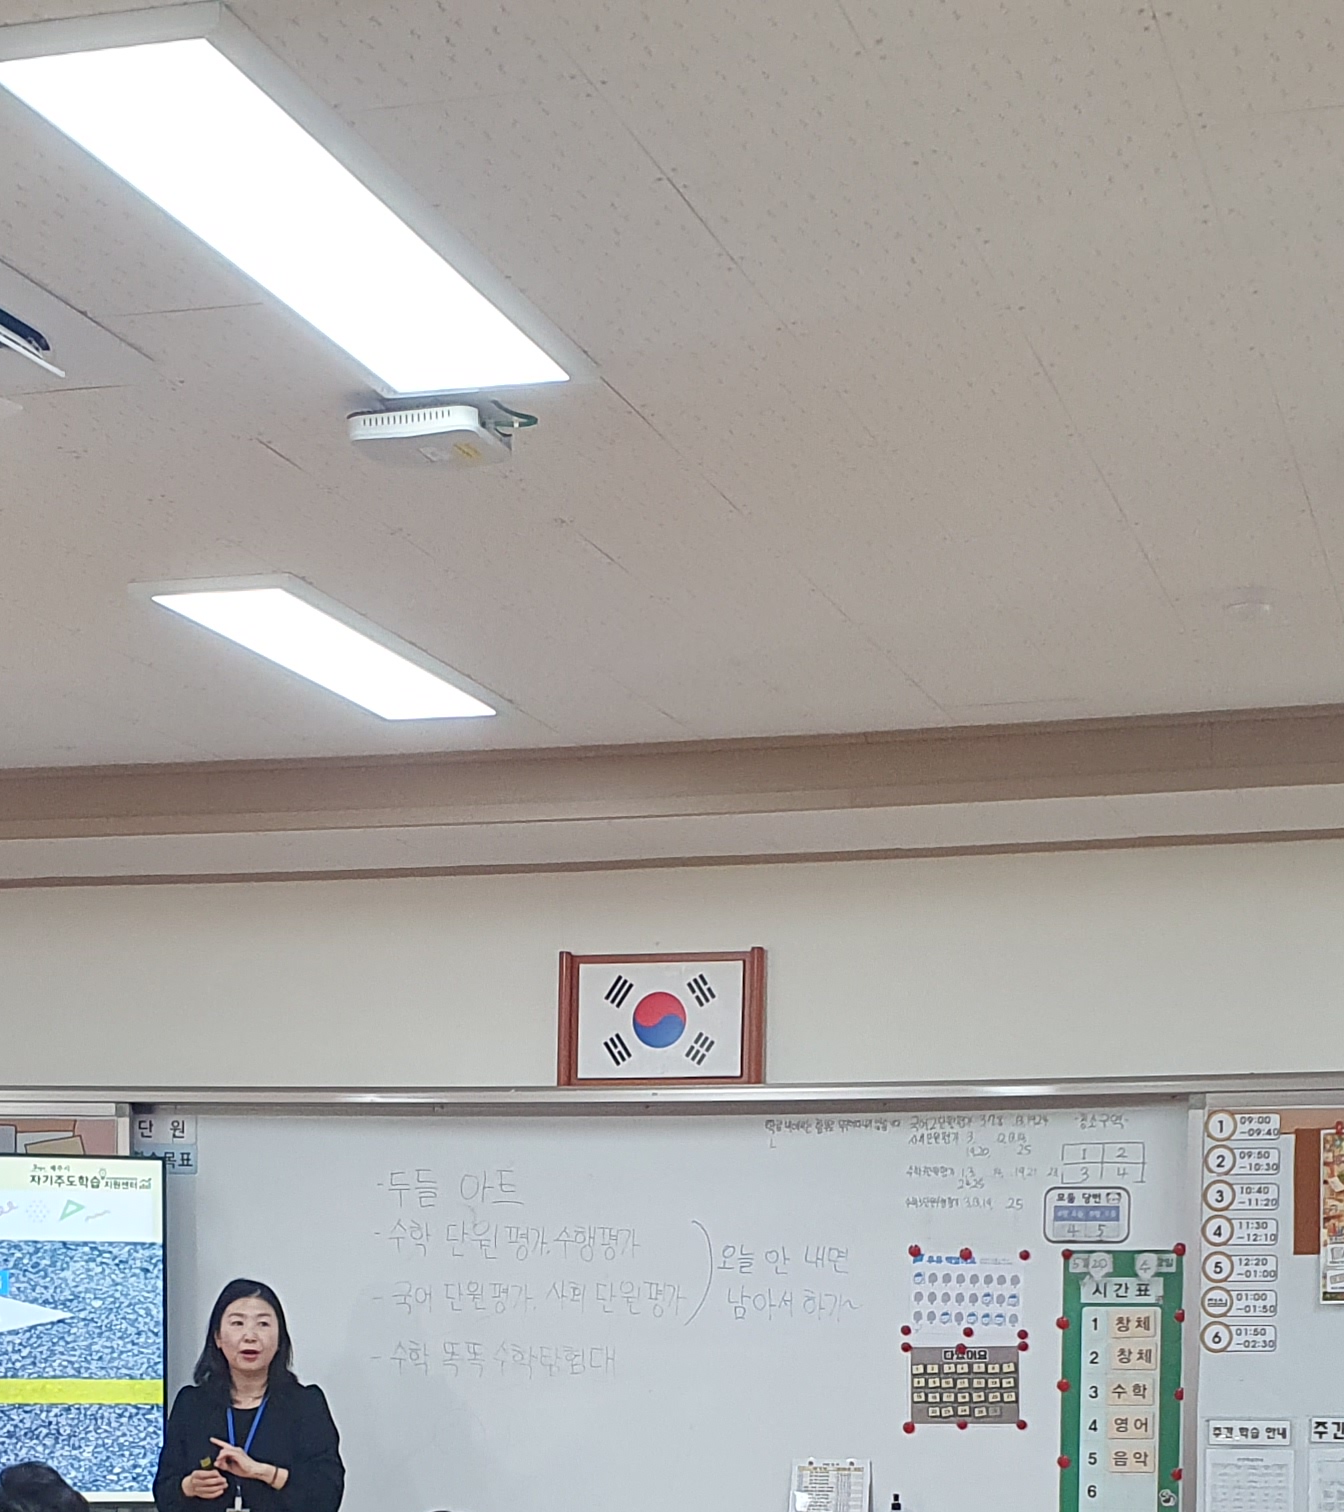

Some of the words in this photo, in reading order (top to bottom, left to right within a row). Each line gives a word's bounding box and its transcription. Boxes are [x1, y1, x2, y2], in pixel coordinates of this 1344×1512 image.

[1218, 1120, 1225, 1133] 1
[1239, 1116, 1271, 1125] 09:00
[138, 1119, 185, 1139] 단원
[1117, 1148, 1128, 1158] 2
[1239, 1151, 1270, 1159] 09:50
[1216, 1155, 1225, 1168] 2
[1080, 1168, 1089, 1181] 3
[1117, 1168, 1128, 1177] 4
[30, 1175, 101, 1190] 자기주도학습
[388, 1169, 438, 1208] 두들
[460, 1169, 524, 1205] 아트
[1215, 1190, 1224, 1203] 3
[1239, 1186, 1270, 1194] 10:40
[1067, 1223, 1079, 1238] 4
[1097, 1223, 1106, 1238] 5
[1213, 1225, 1222, 1238] 4
[1238, 1221, 1268, 1230] 11:30
[388, 1218, 431, 1257] 수학
[717, 1244, 754, 1274] 오늘
[765, 1246, 790, 1275] 안
[805, 1246, 849, 1274] 내면
[1238, 1258, 1268, 1266] 12:20
[1139, 1260, 1151, 1273] 수
[1213, 1262, 1223, 1274] 5
[1092, 1282, 1151, 1298] 시간표
[392, 1281, 432, 1314] 국어
[546, 1280, 586, 1313] 사회
[727, 1285, 793, 1320] 남아서
[1236, 1293, 1267, 1301] 01:00
[1092, 1318, 1098, 1330] 1
[1115, 1316, 1151, 1332] 창체
[1212, 1332, 1221, 1344] 6
[1235, 1328, 1266, 1336] 01:50
[390, 1341, 429, 1376] 수학
[1089, 1352, 1099, 1364] 2
[1117, 1348, 1152, 1364] 창체
[1088, 1387, 1098, 1398] 3
[1111, 1383, 1147, 1400] 수학
[1088, 1420, 1098, 1432] 4
[1114, 1417, 1149, 1433] 영어
[1265, 1427, 1287, 1439] 안내
[1088, 1453, 1097, 1465] 5
[1112, 1450, 1149, 1467] 음악
[1087, 1485, 1097, 1497] 6
